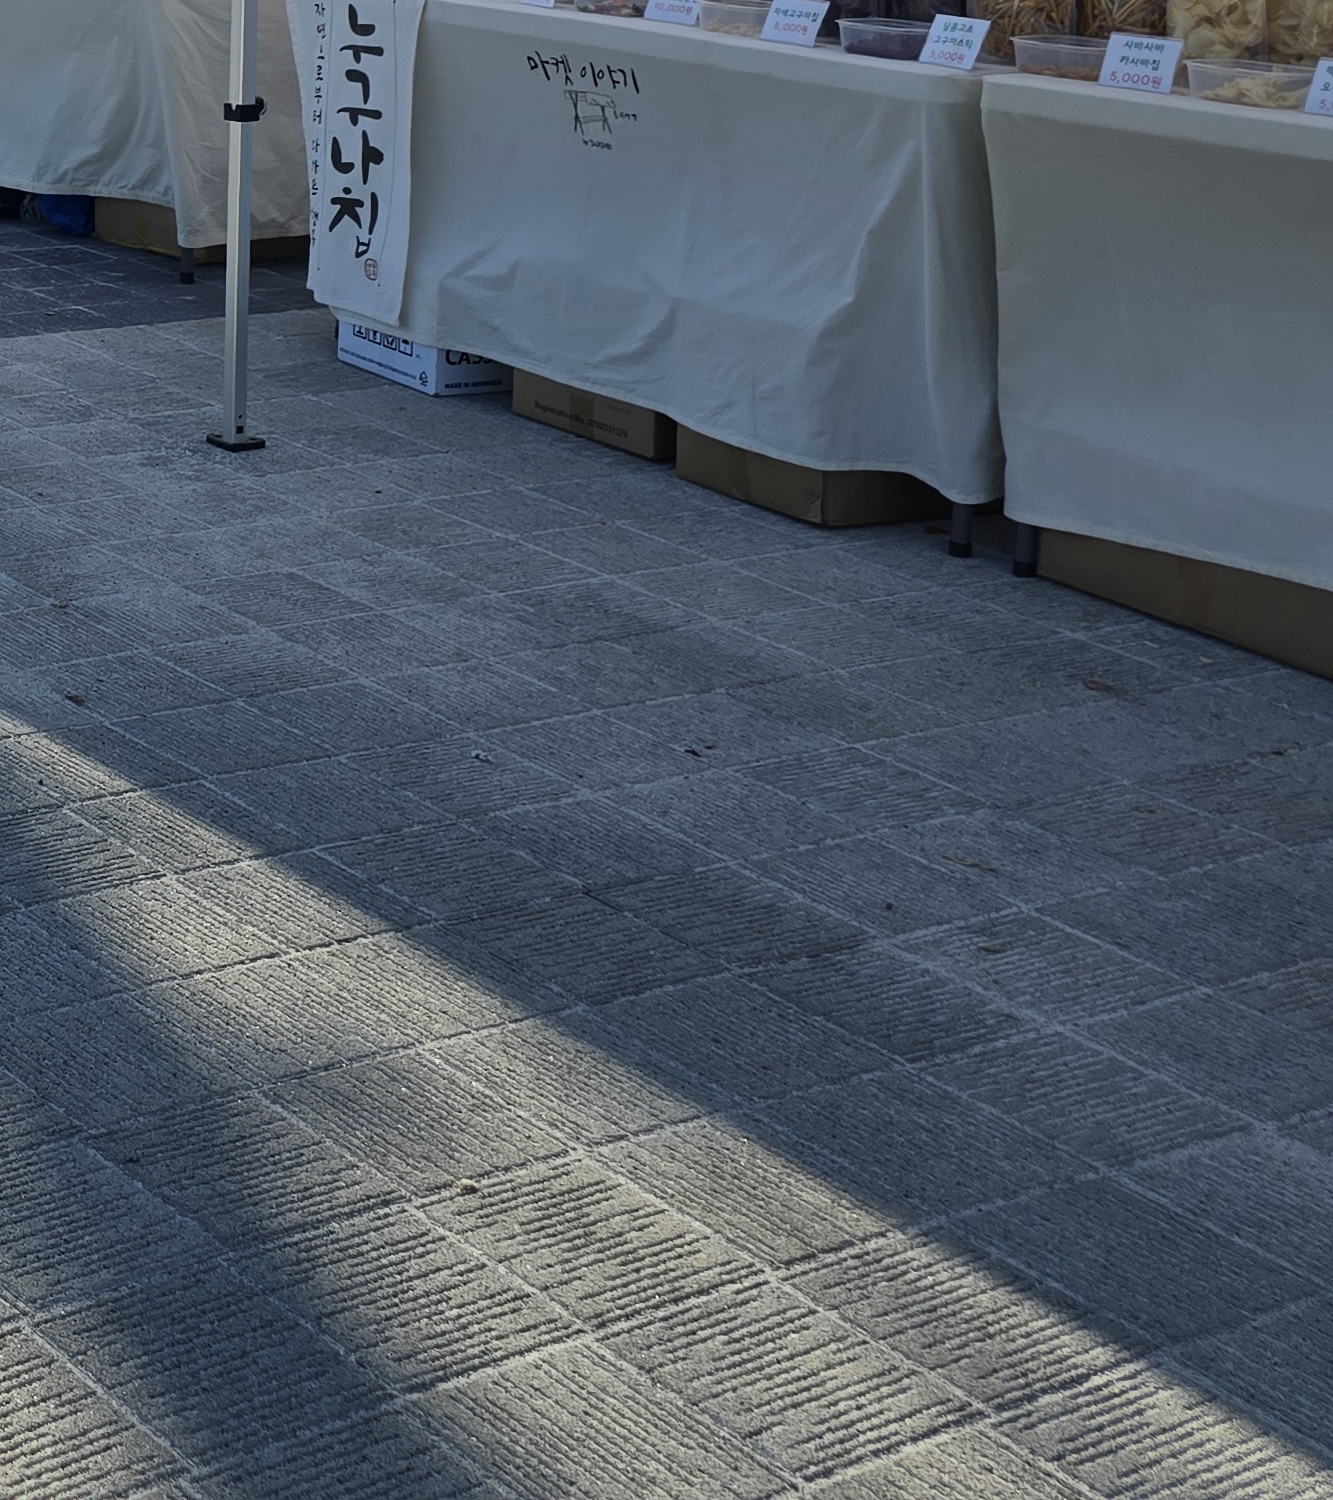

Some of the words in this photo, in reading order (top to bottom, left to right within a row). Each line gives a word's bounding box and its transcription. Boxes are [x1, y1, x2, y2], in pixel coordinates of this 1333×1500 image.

[526, 50, 574, 86] 마켓
[579, 61, 640, 94] 이야기
[1109, 70, 1163, 90] 5,000원
[328, 3, 385, 259] 누구나칩
